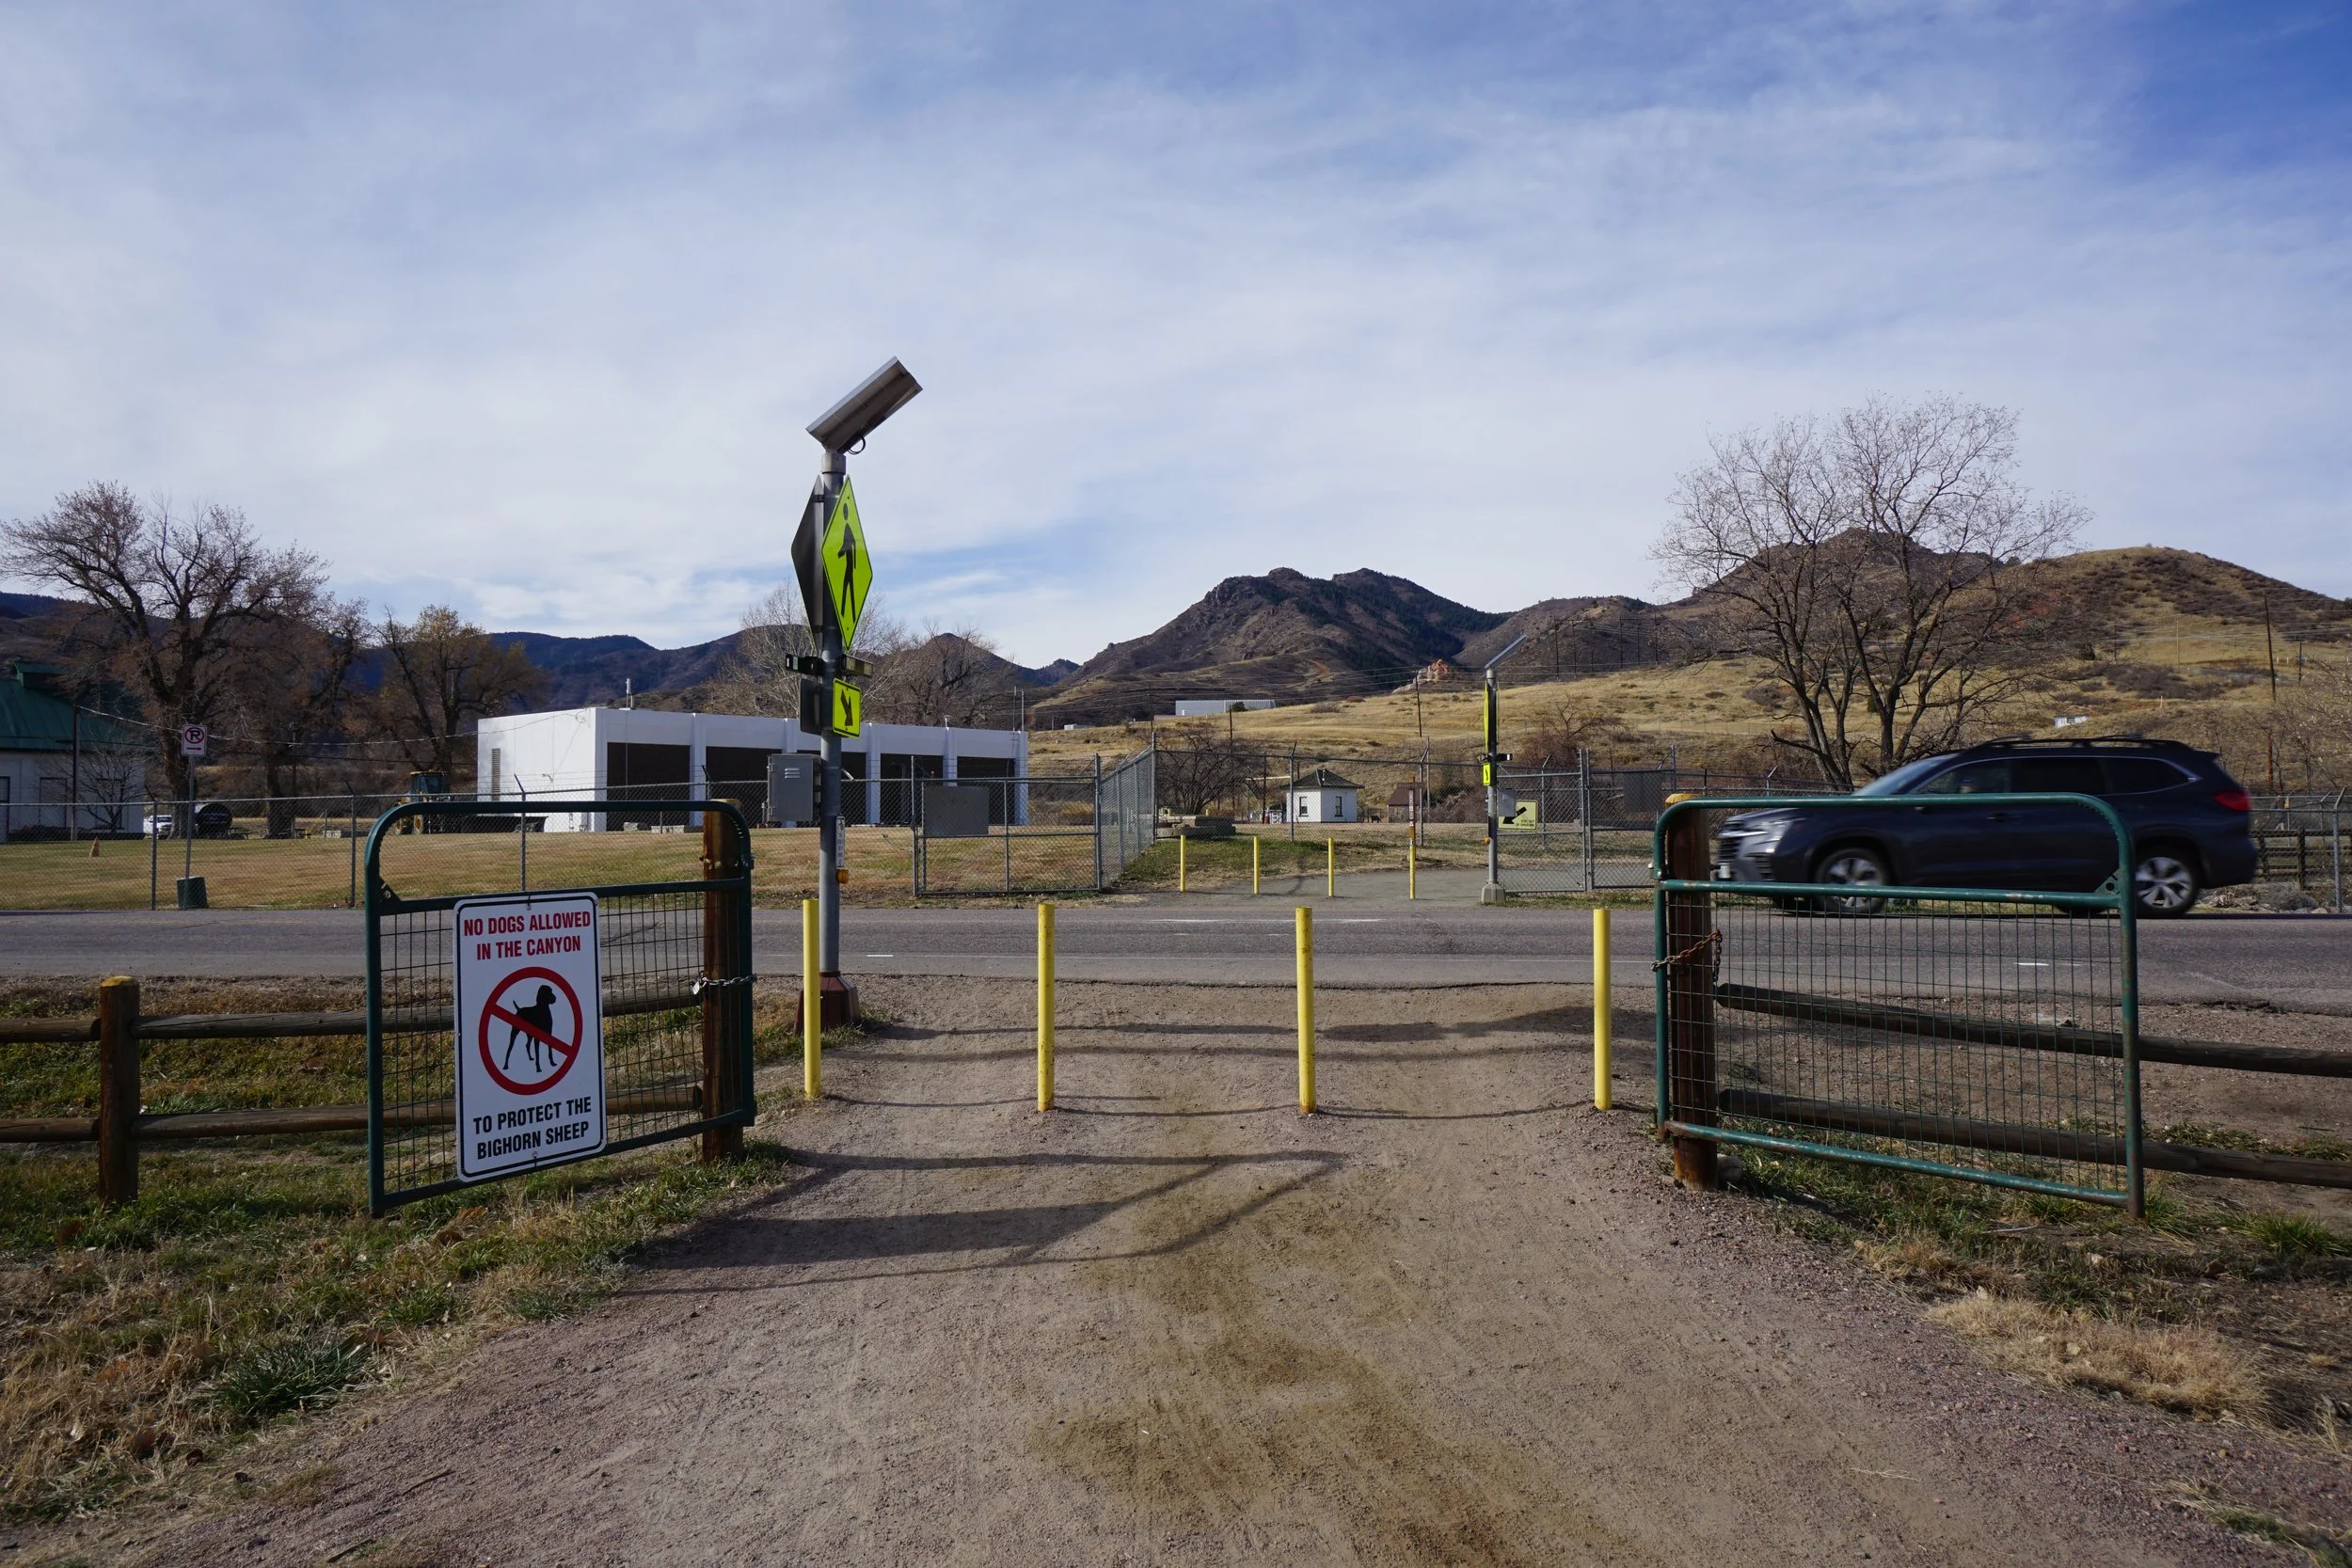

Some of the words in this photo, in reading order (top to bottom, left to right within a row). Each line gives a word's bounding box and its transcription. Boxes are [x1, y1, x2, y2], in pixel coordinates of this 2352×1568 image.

[464, 918, 484, 936] NO
[488, 915, 525, 934] DOGS
[529, 911, 591, 931] ALLOWED
[477, 942, 491, 960] IN
[496, 941, 522, 958] THE
[527, 935, 580, 956] CANYON
[473, 1116, 492, 1134] TO
[498, 1101, 562, 1130] PROTECT
[566, 1096, 592, 1116] THE
[477, 1131, 541, 1160] BIGHORN
[546, 1121, 589, 1145] SHEEP
